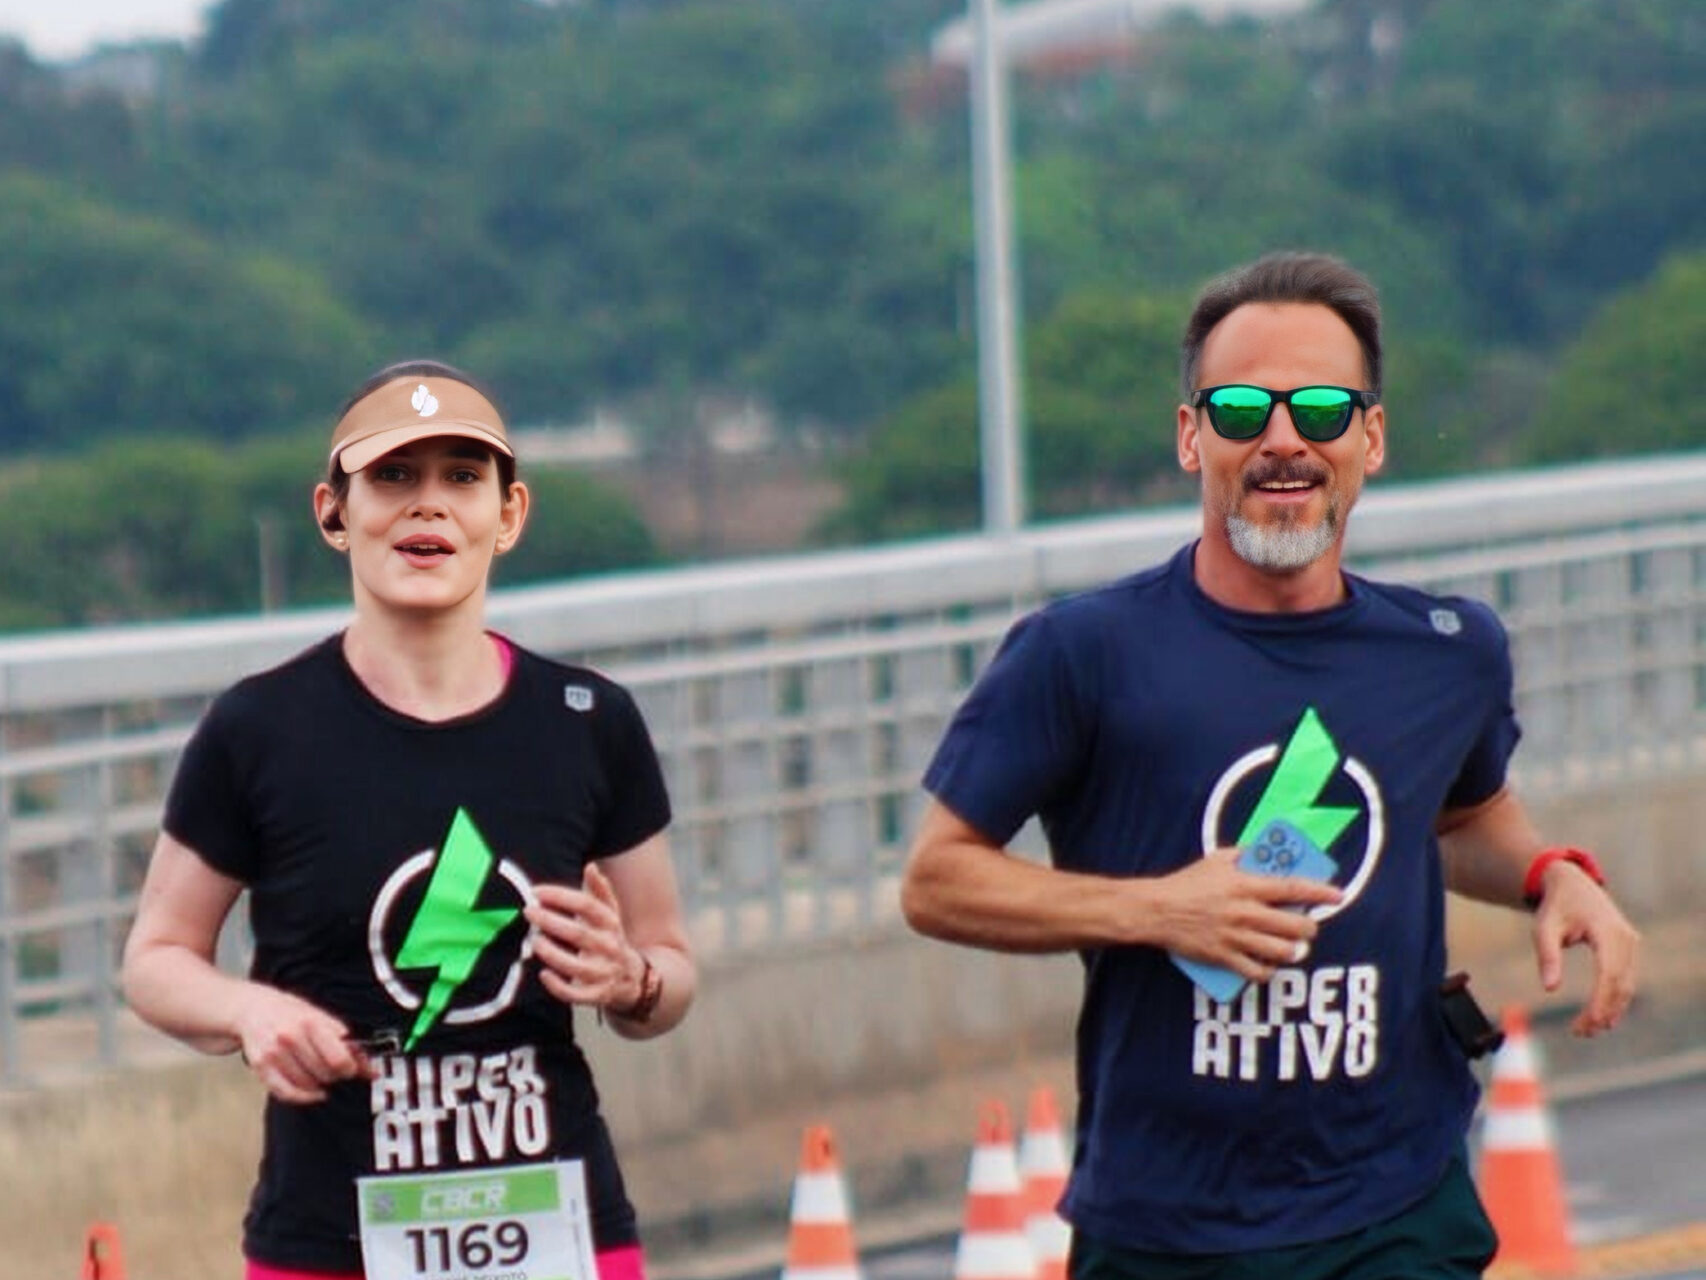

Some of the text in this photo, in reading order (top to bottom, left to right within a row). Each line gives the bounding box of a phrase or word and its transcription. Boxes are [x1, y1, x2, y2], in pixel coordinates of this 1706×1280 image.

[371, 1046, 546, 1114] HIPER
[1192, 1012, 1378, 1080] ATIVO
[374, 1087, 548, 1170] ATIVO
[405, 1220, 530, 1273] 1169
